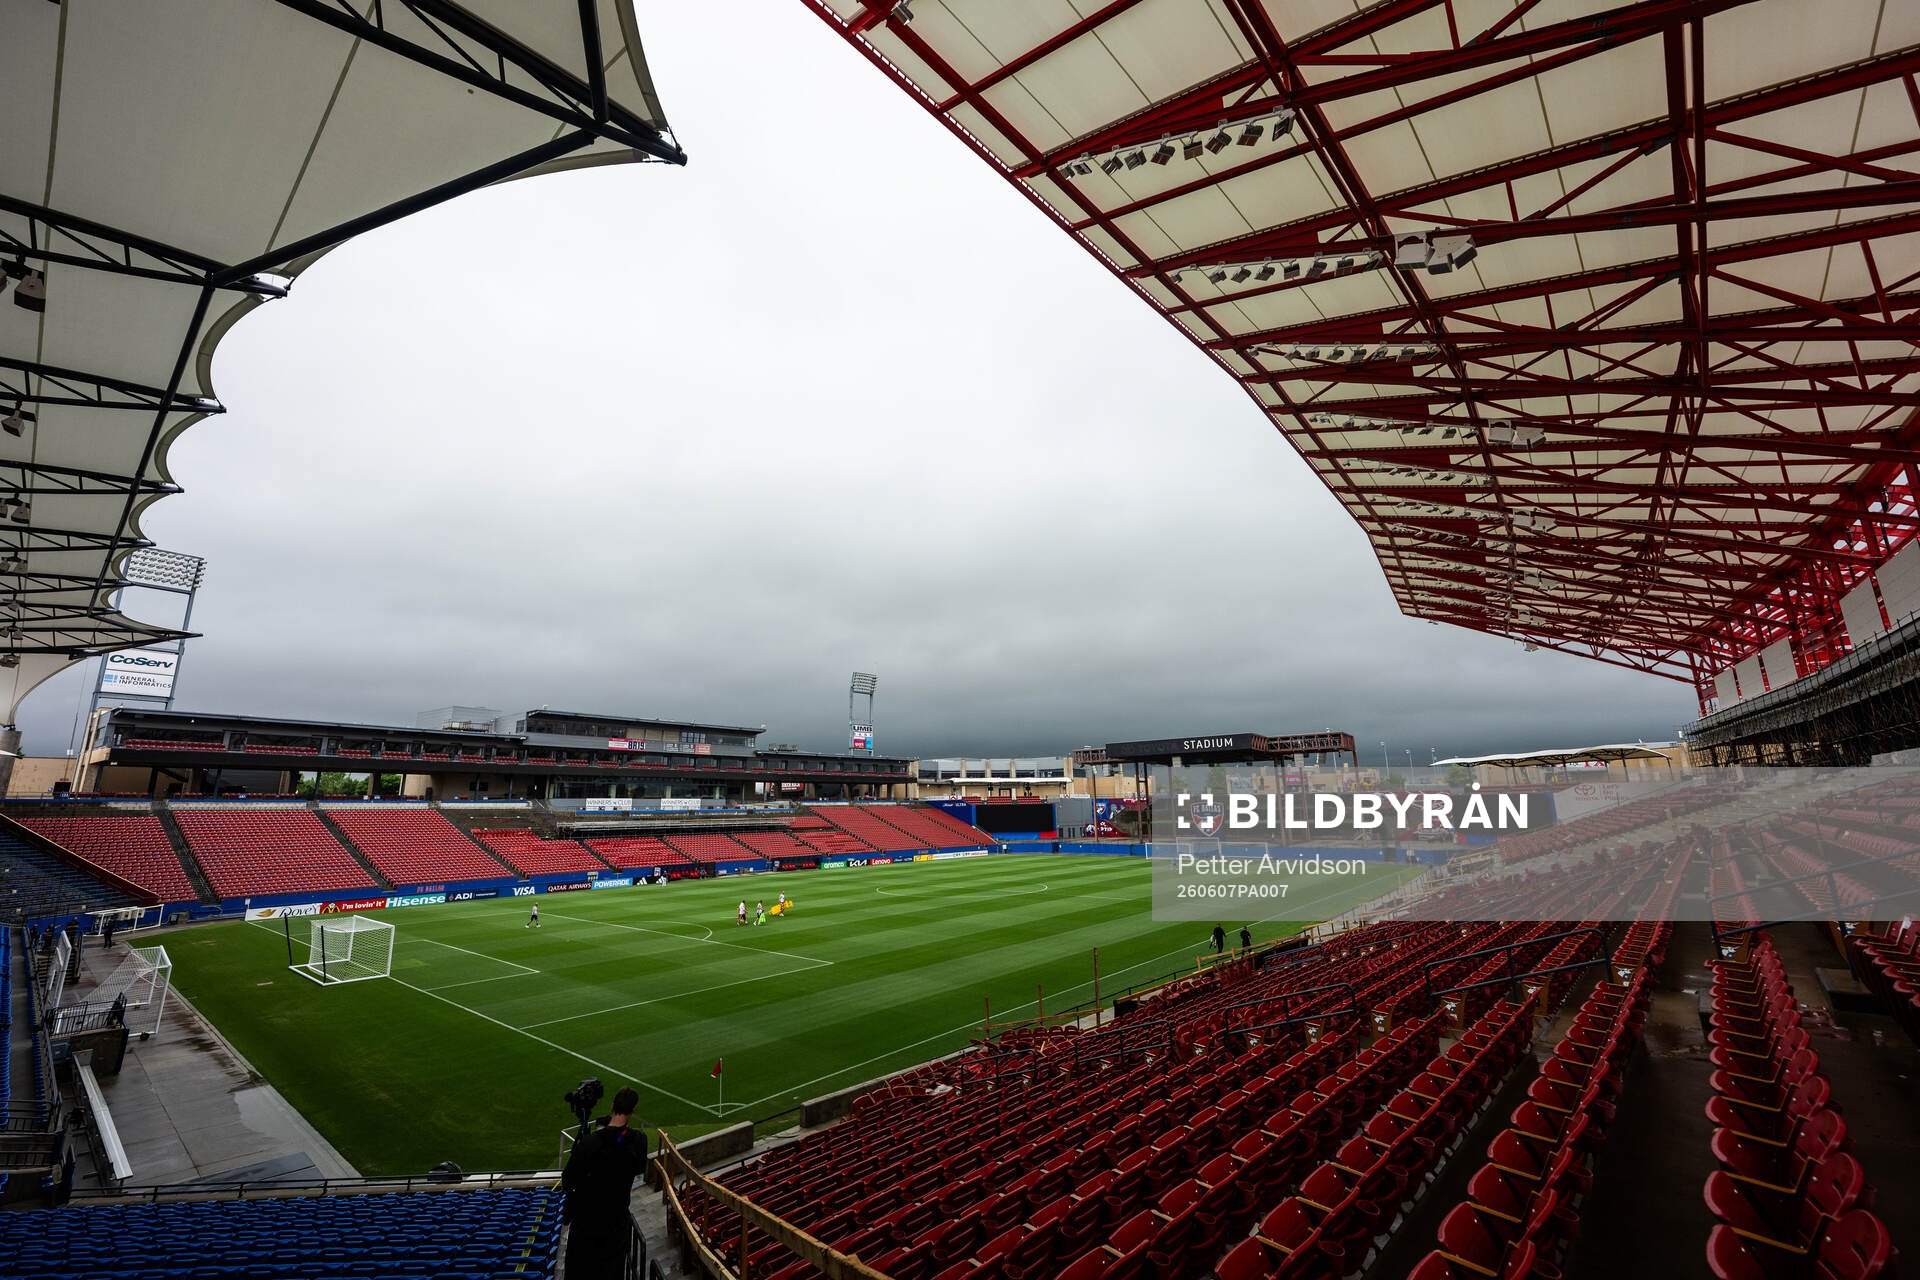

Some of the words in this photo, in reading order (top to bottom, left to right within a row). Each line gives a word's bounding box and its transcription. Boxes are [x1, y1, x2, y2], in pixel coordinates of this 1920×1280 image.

[109, 654, 174, 668] CoServ
[119, 680, 172, 688] INFORMATICS
[120, 675, 156, 683] GENERAL
[1183, 738, 1233, 750] STADIUM
[823, 861, 845, 869] aramco
[547, 884, 567, 892] QATAR
[568, 882, 592, 890] AIRWAYS
[594, 879, 630, 888] POWERADE
[455, 892, 473, 900] ADI
[511, 886, 536, 896] VISA
[386, 894, 446, 907] Hisense
[279, 906, 313, 918] Dove
